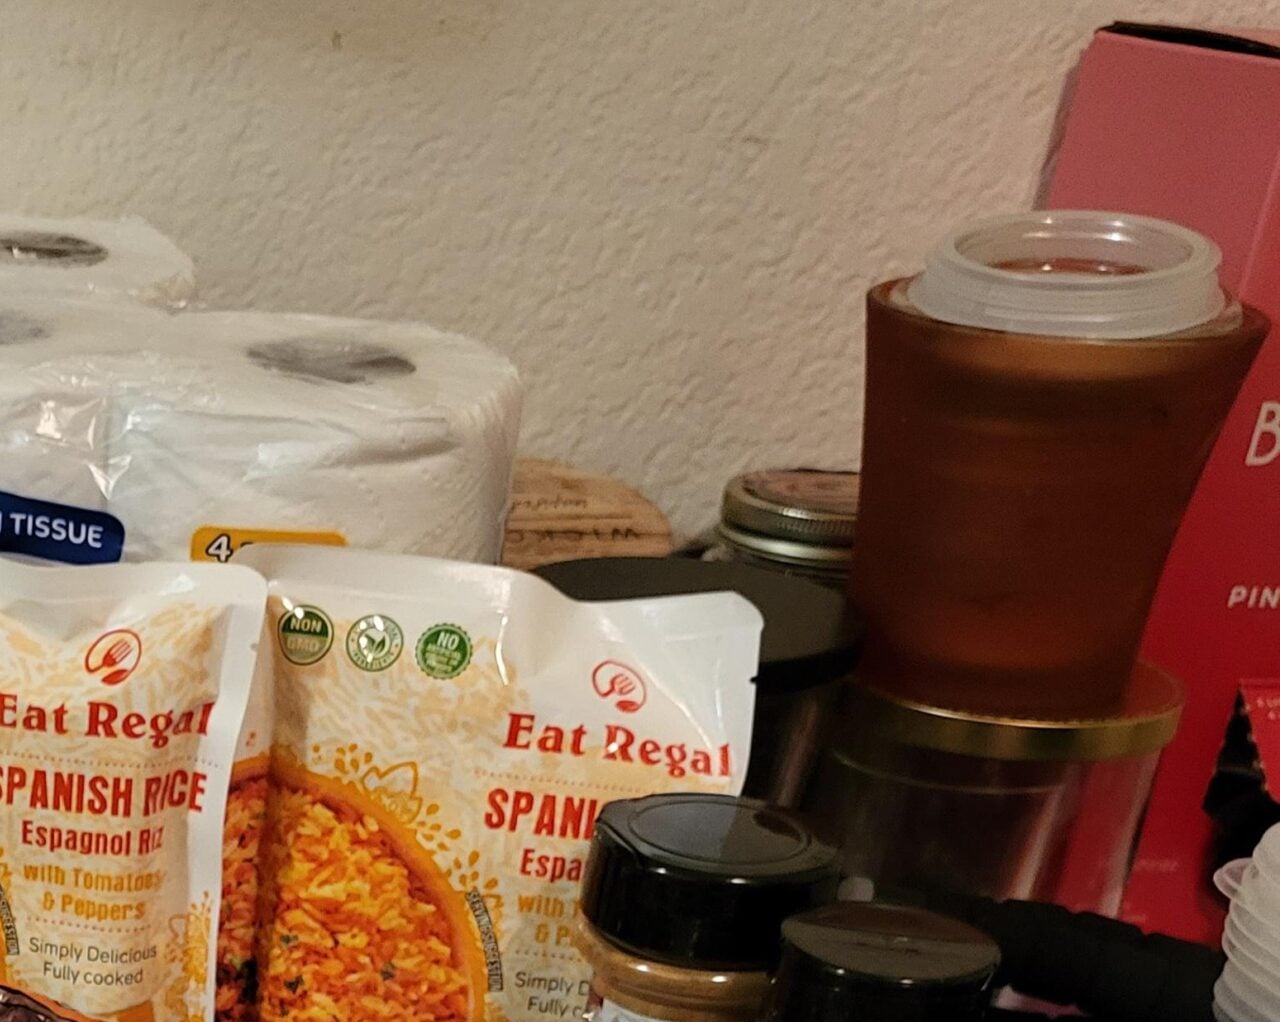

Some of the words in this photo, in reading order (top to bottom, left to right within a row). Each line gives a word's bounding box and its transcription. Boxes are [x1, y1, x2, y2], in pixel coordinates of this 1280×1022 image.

[10, 513, 104, 548] TISSUE
[208, 536, 233, 562] 4
[290, 618, 321, 632] NON
[437, 630, 459, 649] NO
[85, 701, 215, 749] Regal
[503, 713, 586, 756] Eat
[603, 724, 730, 778] Regal
[143, 770, 207, 817] RICE
[485, 788, 596, 841] SPANI
[21, 820, 132, 856] Espagnol
[23, 864, 65, 886] with
[520, 848, 582, 883] Espa
[43, 891, 55, 911] &
[61, 894, 145, 921] Peppers
[518, 895, 564, 917] with
[29, 936, 83, 962] Simply
[87, 944, 157, 964] Delicious
[43, 962, 80, 984] Fully
[84, 968, 144, 986] cooked
[515, 972, 573, 993] Simply
[528, 997, 568, 1017] Fully
